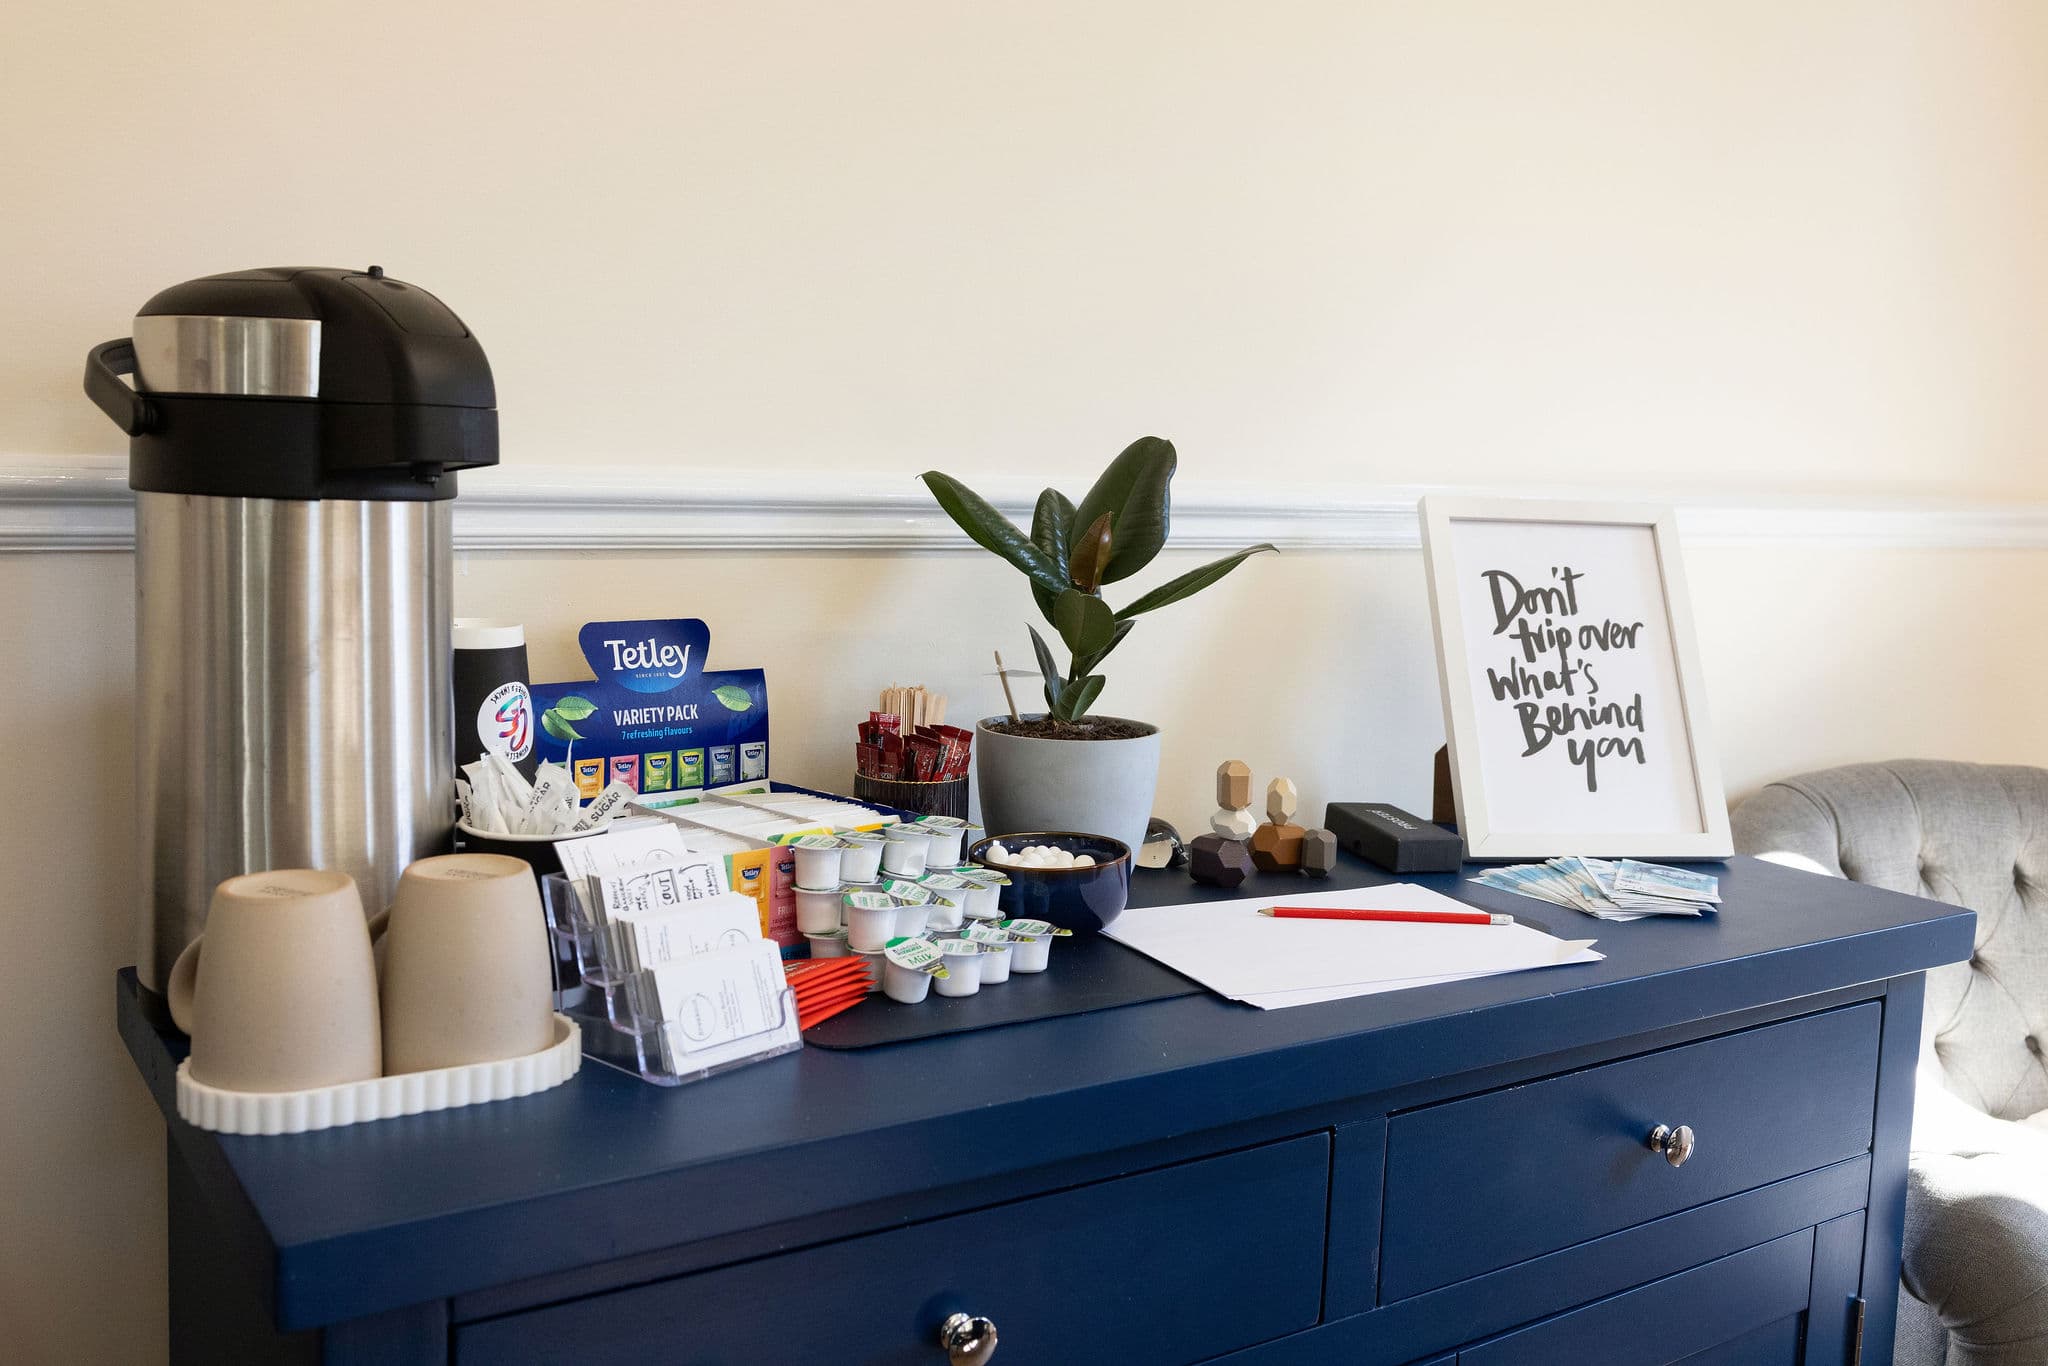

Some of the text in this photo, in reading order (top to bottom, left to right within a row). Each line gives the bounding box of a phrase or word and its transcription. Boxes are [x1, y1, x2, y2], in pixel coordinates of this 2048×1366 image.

[1481, 566, 1585, 635] Don't
[1509, 618, 1643, 662] trip over
[603, 638, 691, 678] Tetley
[613, 703, 699, 727] VARIETY PACK
[1513, 693, 1644, 757] Behind
[626, 728, 664, 740] refreshing
[664, 726, 693, 736] flavours
[591, 791, 622, 822] SUGAR
[743, 868, 760, 877] Tetley
[907, 953, 933, 966] Milk
